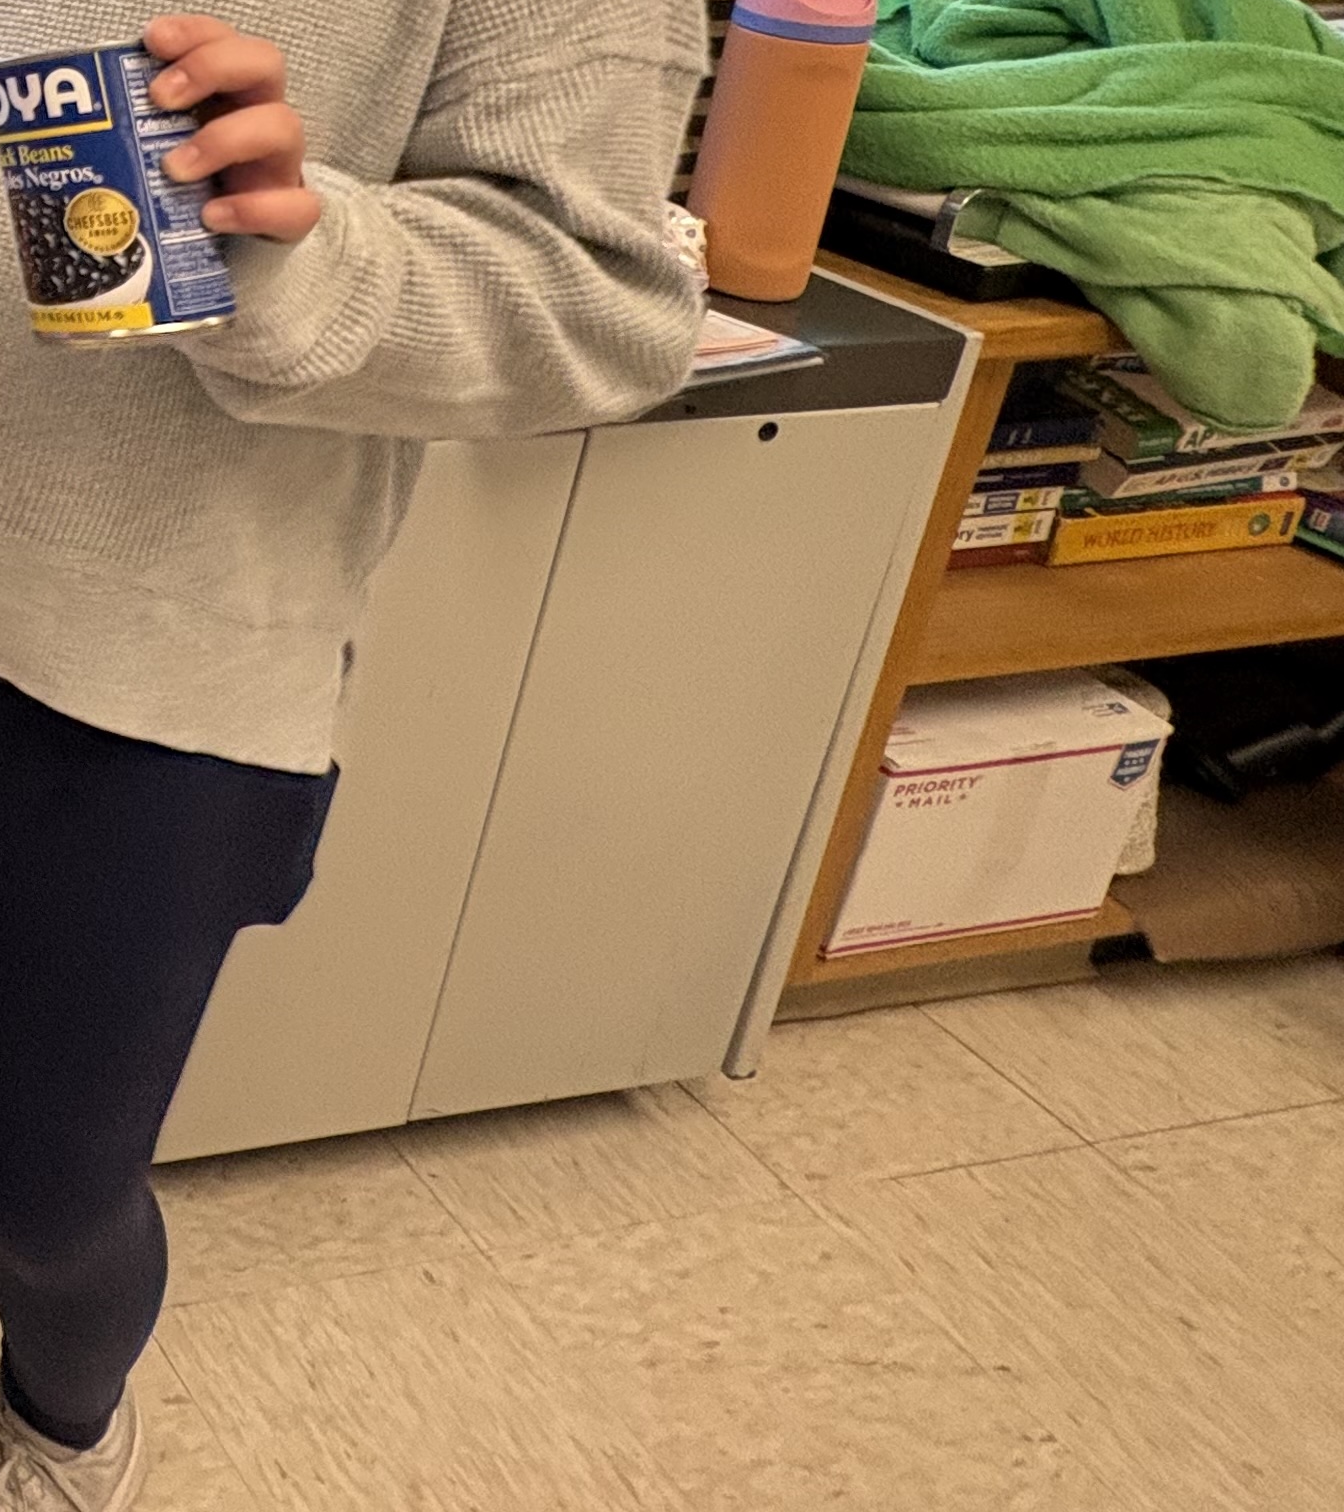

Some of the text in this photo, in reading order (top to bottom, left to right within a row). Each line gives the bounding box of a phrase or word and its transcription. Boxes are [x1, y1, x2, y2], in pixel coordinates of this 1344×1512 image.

[18, 145, 74, 166] Beans
[893, 775, 978, 797] PRIORITY
[907, 795, 952, 809] MAIL
